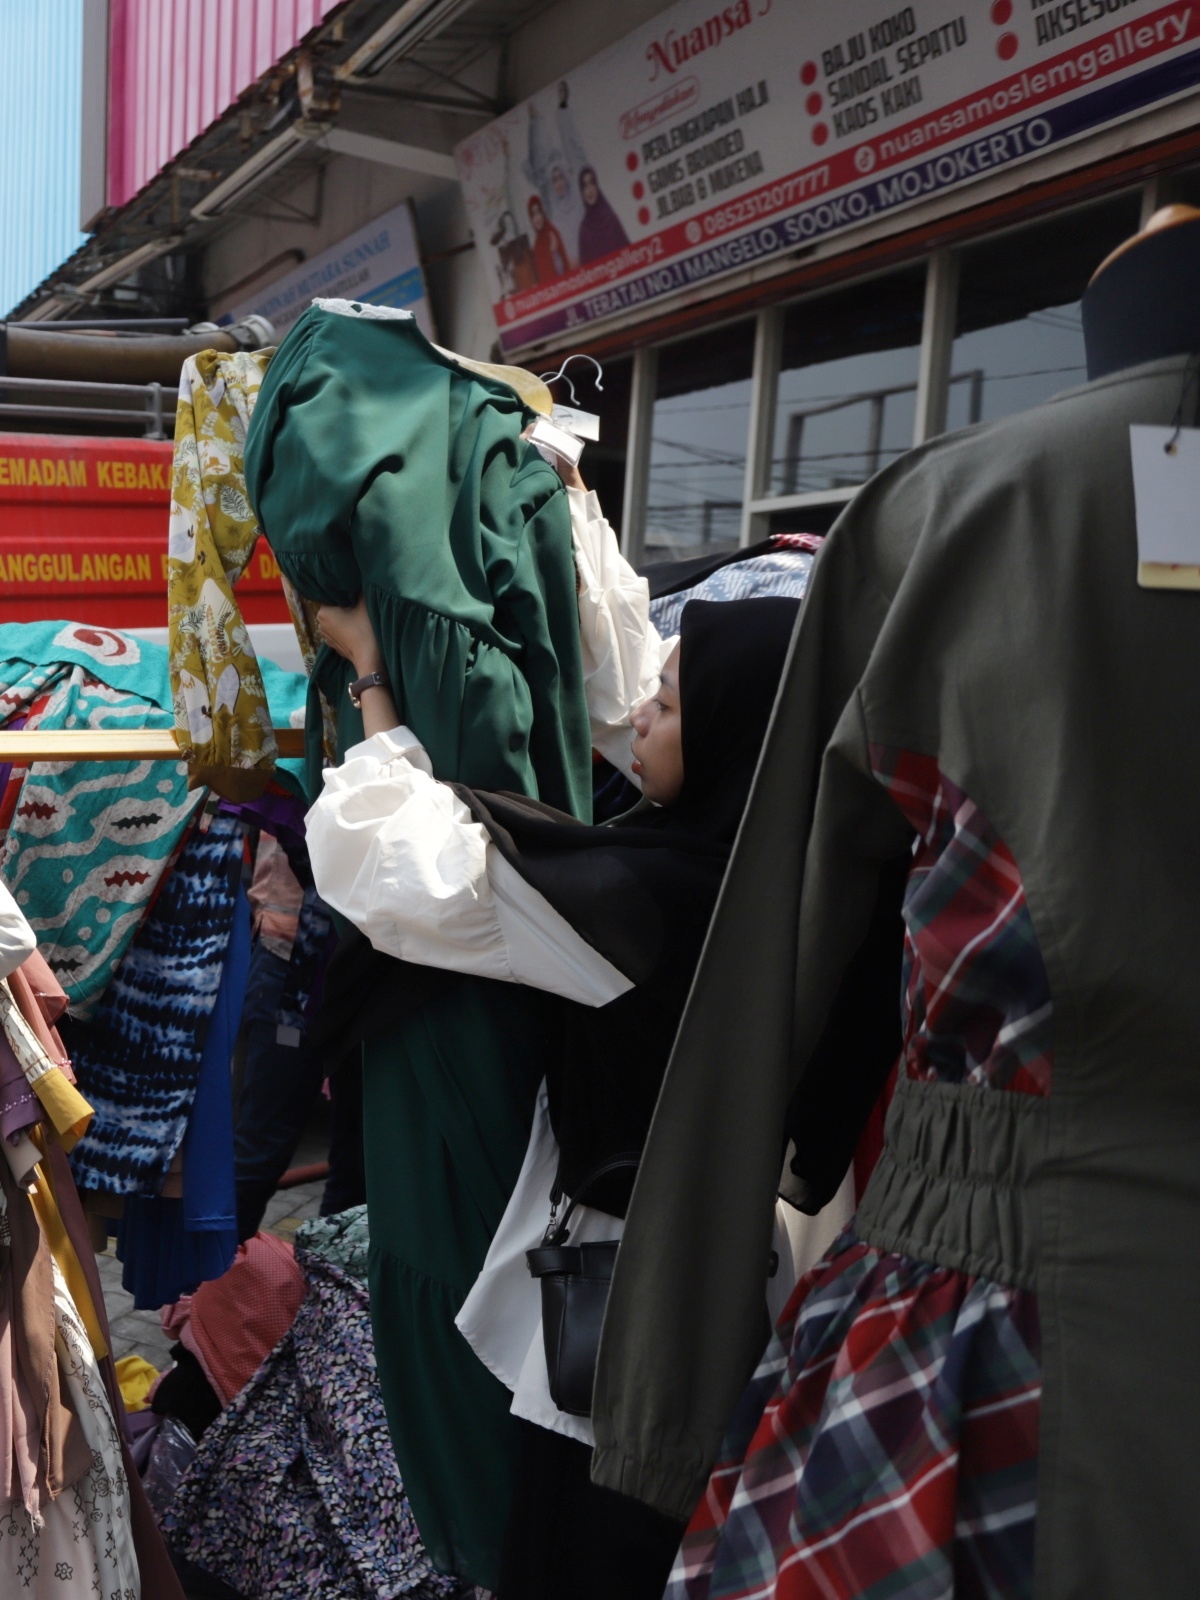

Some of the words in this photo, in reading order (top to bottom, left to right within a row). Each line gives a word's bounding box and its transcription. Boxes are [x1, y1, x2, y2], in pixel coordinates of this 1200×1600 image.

[646, 0, 752, 81] Nuansa
[822, 32, 866, 77] BAJU
[869, 6, 916, 53] KOKO
[828, 56, 893, 108] SANDAL
[896, 15, 967, 74] SEPATU
[704, 165, 830, 235] 085231207777
[880, 8, 1192, 161] nuansamoslemgallery
[832, 97, 878, 138] KAOS
[881, 76, 923, 117] KAKI
[586, 281, 646, 319] TERATAI
[684, 228, 784, 279] MANGELO,
[785, 192, 875, 242] SOOKO,
[878, 117, 1052, 206] MOJOKERTO
